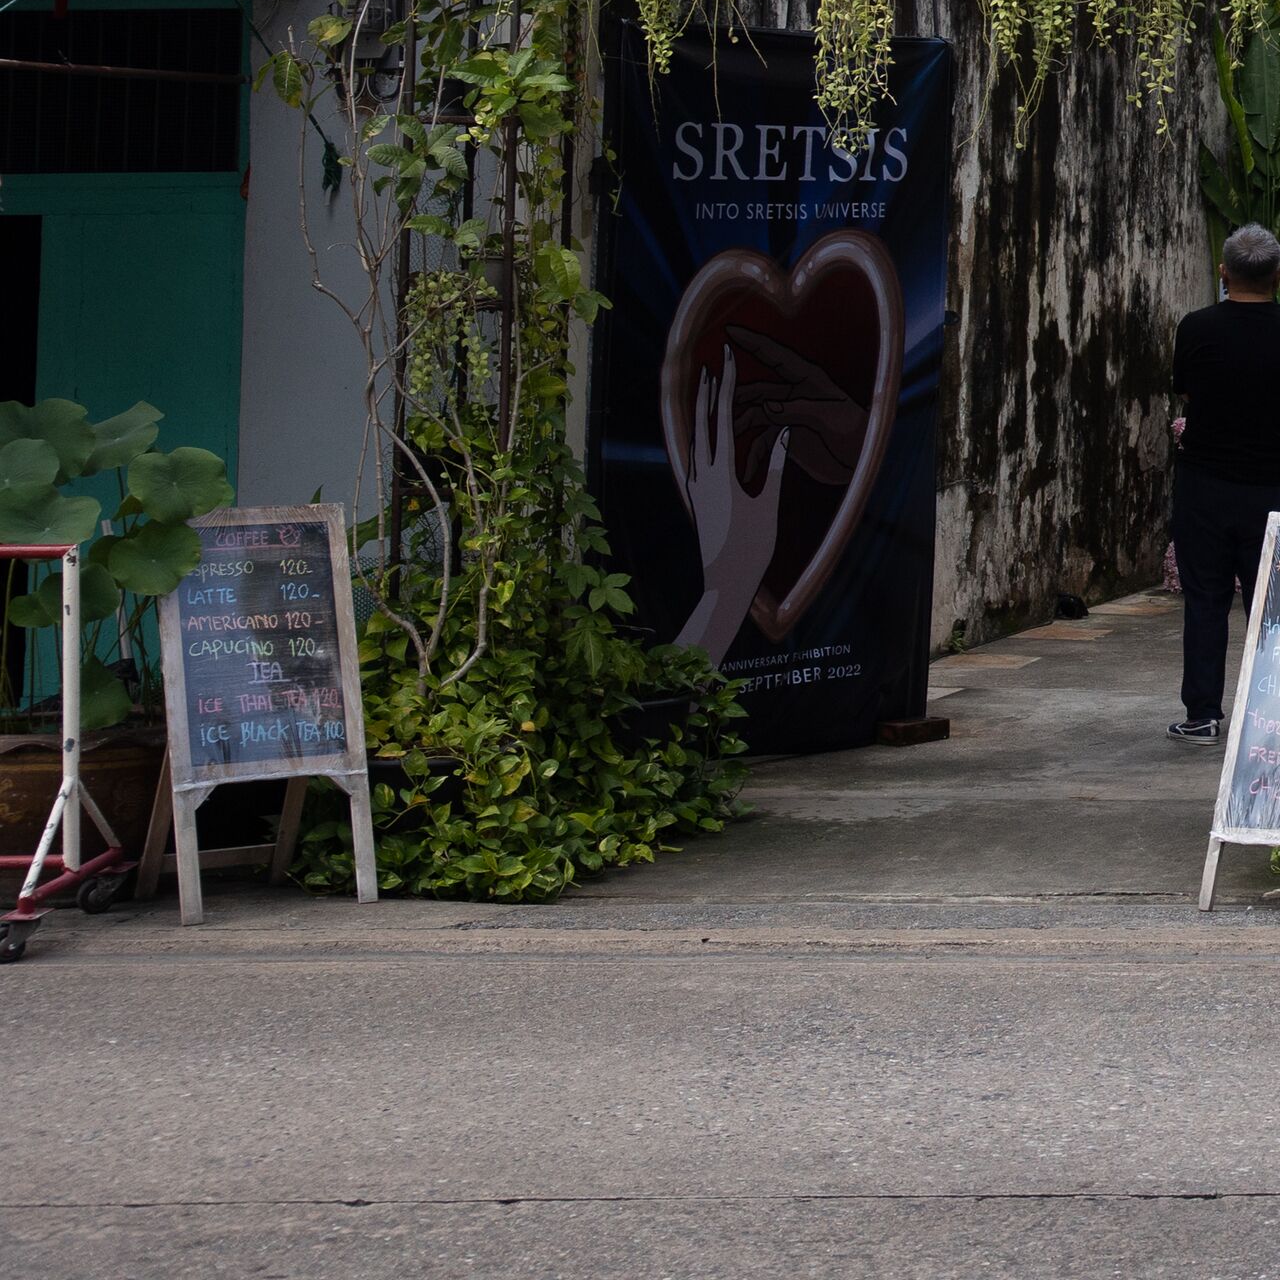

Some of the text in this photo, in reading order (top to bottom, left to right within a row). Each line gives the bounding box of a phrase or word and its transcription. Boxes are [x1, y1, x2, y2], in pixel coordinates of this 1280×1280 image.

[672, 121, 908, 183] SRETSIS
[695, 202, 886, 220] INTO SRETSIS UNIVERSE
[215, 530, 269, 547] COFFEE
[188, 560, 255, 584] SPRESSO
[187, 587, 238, 606] LATTE
[246, 661, 285, 681] TEA
[721, 653, 789, 673] ANNIVERSARY
[827, 663, 862, 680] 2022
[240, 719, 290, 748] BLACK
[296, 720, 321, 742] TEA
